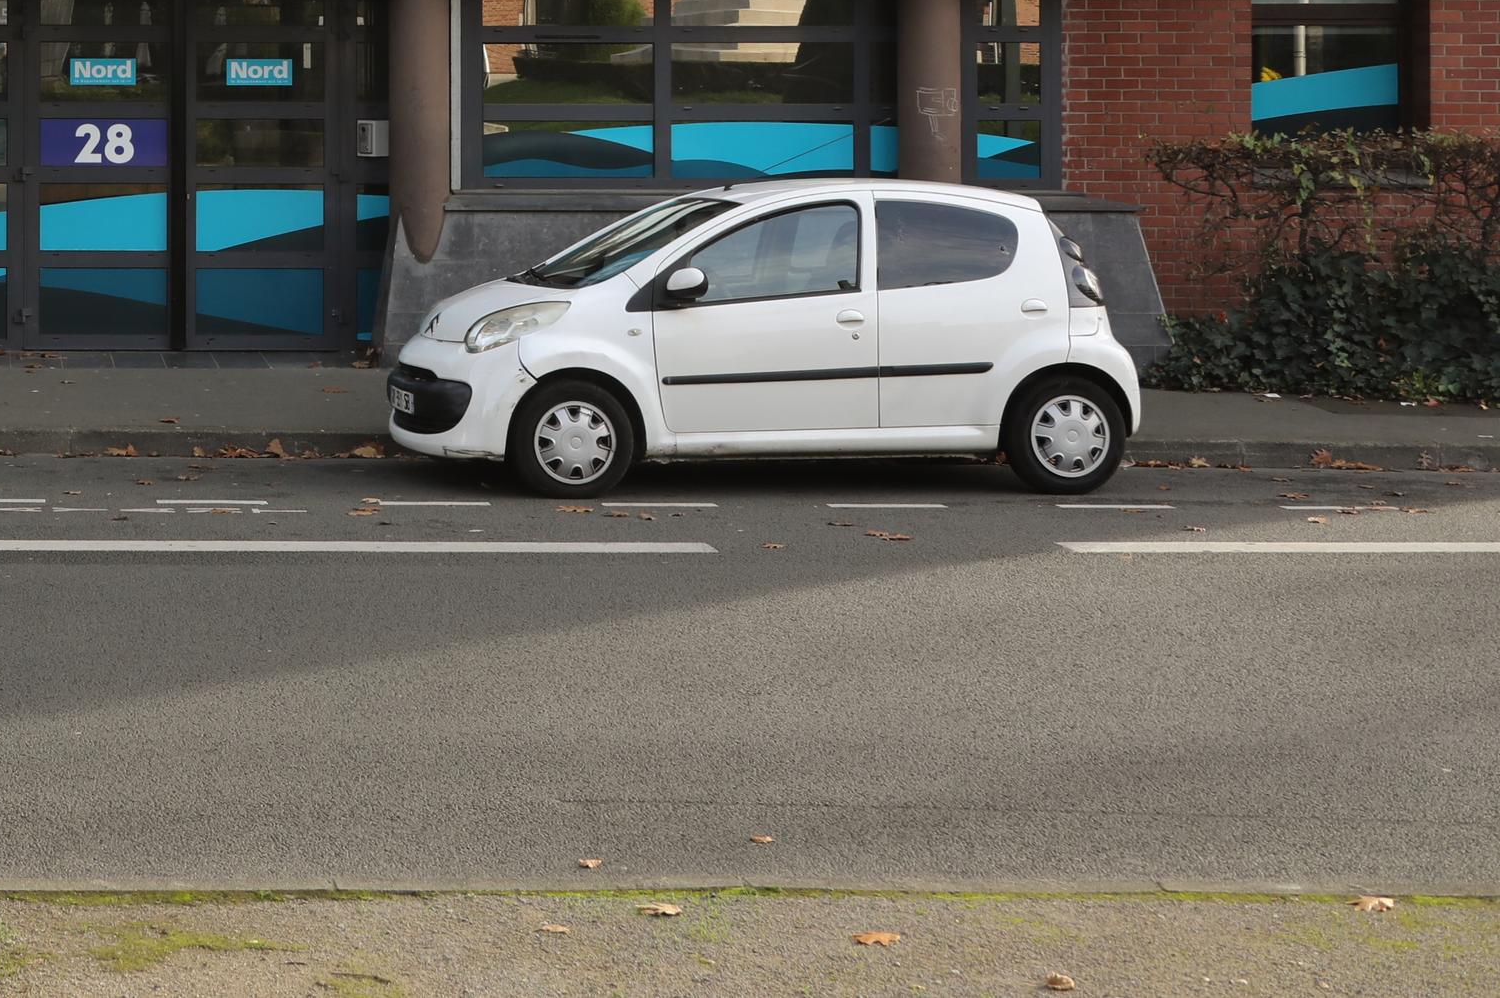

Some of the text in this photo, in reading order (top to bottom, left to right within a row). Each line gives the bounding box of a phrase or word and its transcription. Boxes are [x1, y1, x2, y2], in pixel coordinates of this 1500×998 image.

[74, 60, 132, 78] Nord
[230, 60, 288, 78] Nord
[74, 123, 135, 164] 28
